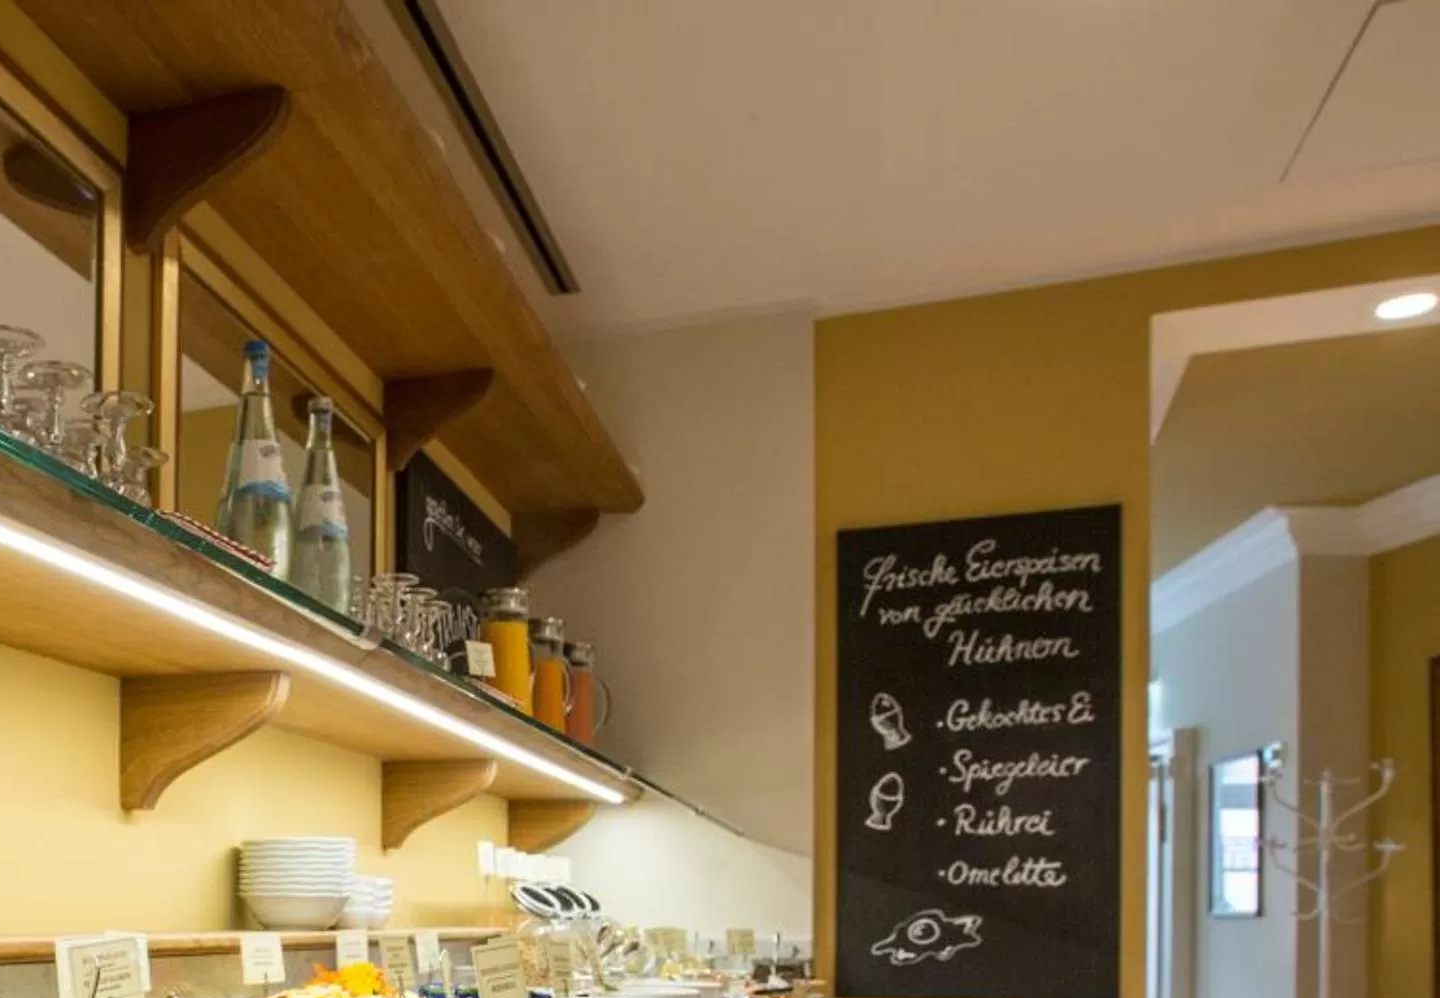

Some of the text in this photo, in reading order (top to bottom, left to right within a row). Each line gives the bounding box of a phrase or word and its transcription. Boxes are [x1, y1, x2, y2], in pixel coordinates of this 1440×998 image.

[964, 538, 1104, 588] Eierspeisen
[877, 579, 1095, 639] von glücklichen
[946, 690, 1097, 732] Gekochtes Ei
[947, 748, 1092, 797] Spiegeleier
[954, 803, 1057, 837] Rührei
[946, 855, 1069, 888] Omelette
